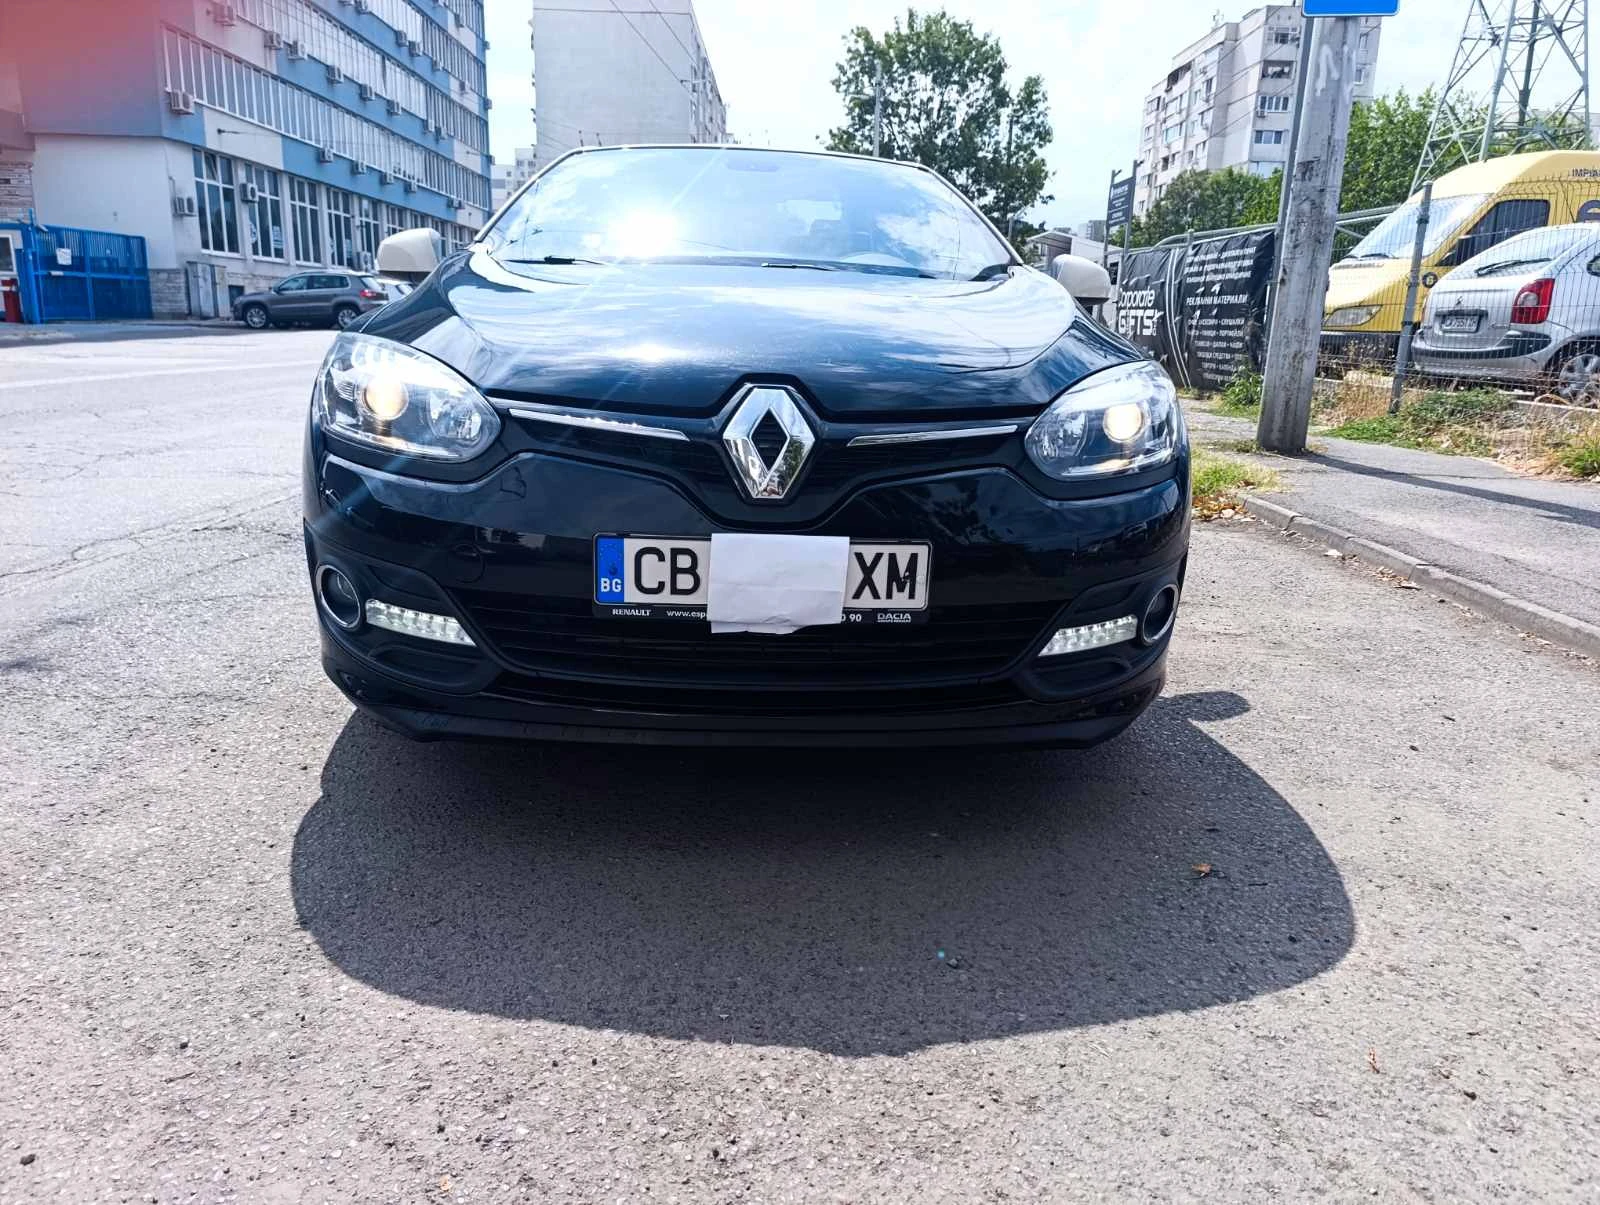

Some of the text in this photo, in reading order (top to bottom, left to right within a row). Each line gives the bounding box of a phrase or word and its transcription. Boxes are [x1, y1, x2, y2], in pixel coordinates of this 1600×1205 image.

[1572, 168, 1600, 177] IMPIA
[1213, 294, 1248, 305] МАТЕРИАЛИ
[634, 547, 919, 600] CB XM
[600, 577, 622, 593] BG
[612, 608, 651, 616] RENAULT
[666, 610, 708, 619] www.esp
[849, 613, 862, 622] 90
[877, 612, 911, 620] DACIA
